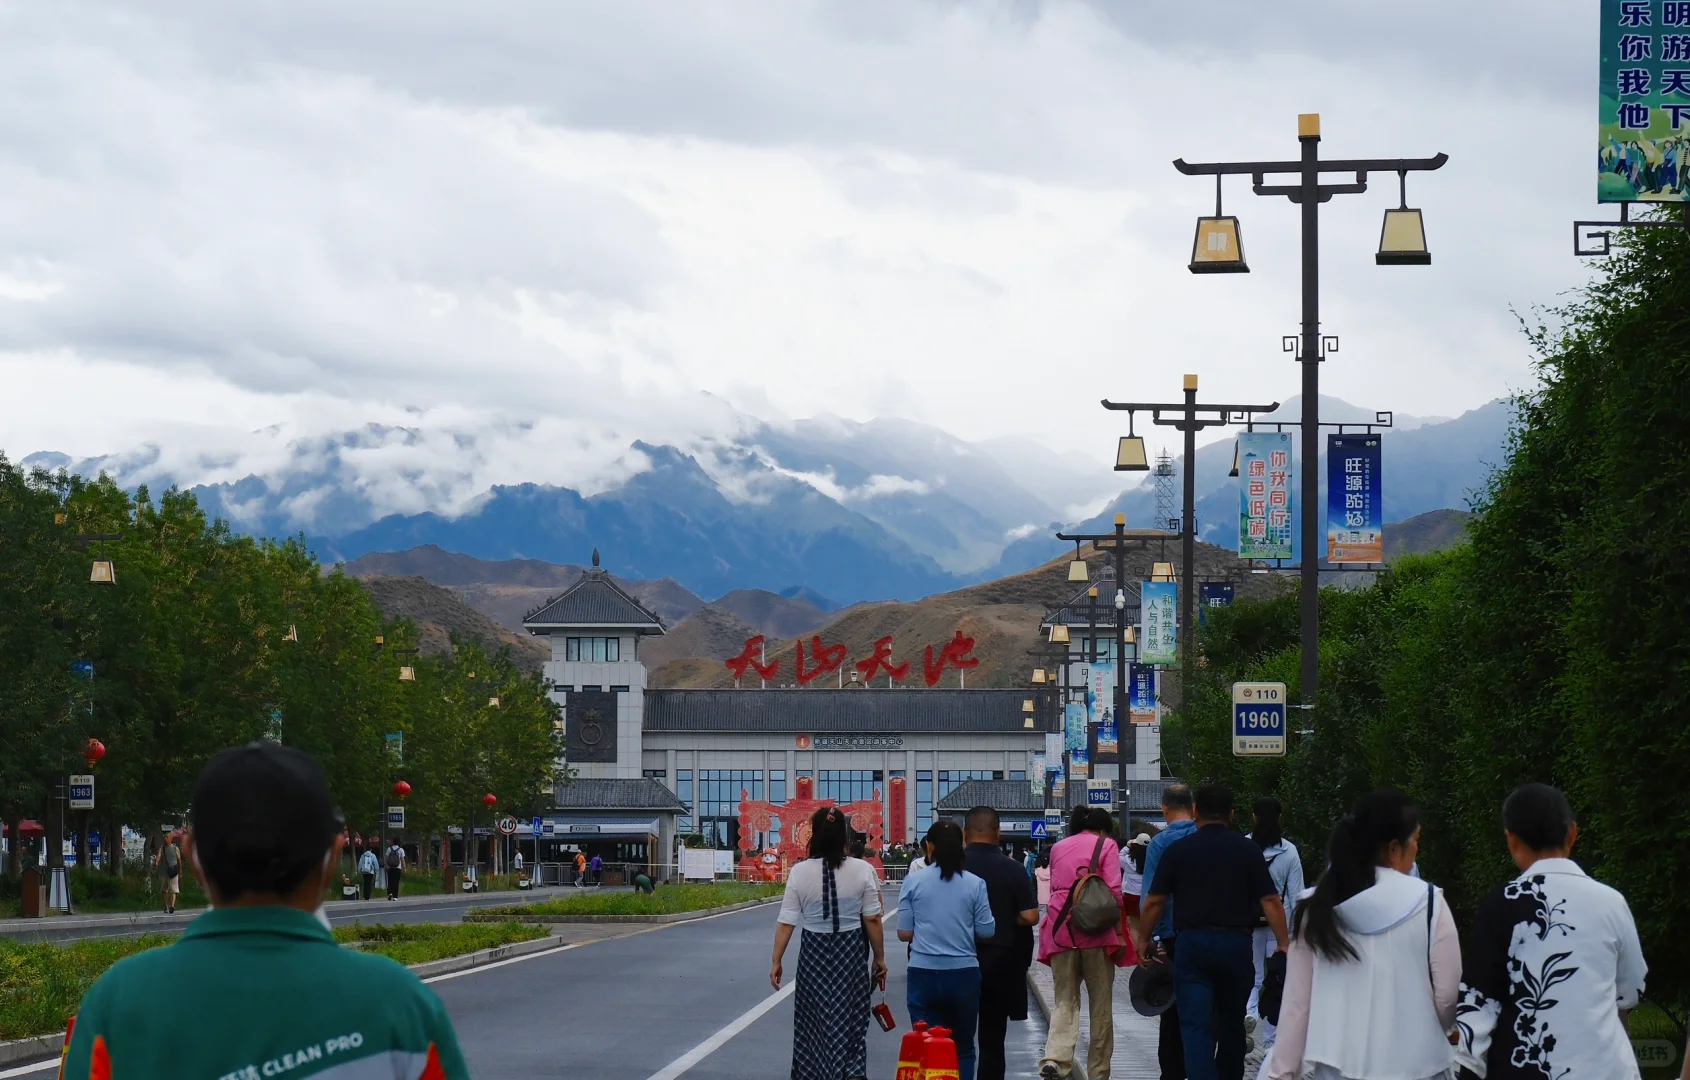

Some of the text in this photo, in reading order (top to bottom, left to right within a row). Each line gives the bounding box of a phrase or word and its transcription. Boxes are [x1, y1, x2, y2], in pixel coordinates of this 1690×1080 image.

[1617, 0, 1651, 129] 乐你我他
[1248, 460, 1266, 537] 绿色低碳
[1269, 451, 1287, 527] 你我同行
[1147, 599, 1159, 649] 人与自然
[1161, 594, 1173, 645] 和谐共生
[725, 630, 979, 687] 天山天池
[1256, 689, 1278, 700] 110
[1239, 711, 1280, 729] 1960
[72, 788, 91, 797] 1963
[1090, 792, 1109, 801] 1962
[501, 820, 514, 830] 40
[262, 1044, 322, 1077] CLEAN
[325, 1032, 364, 1056] PRO
